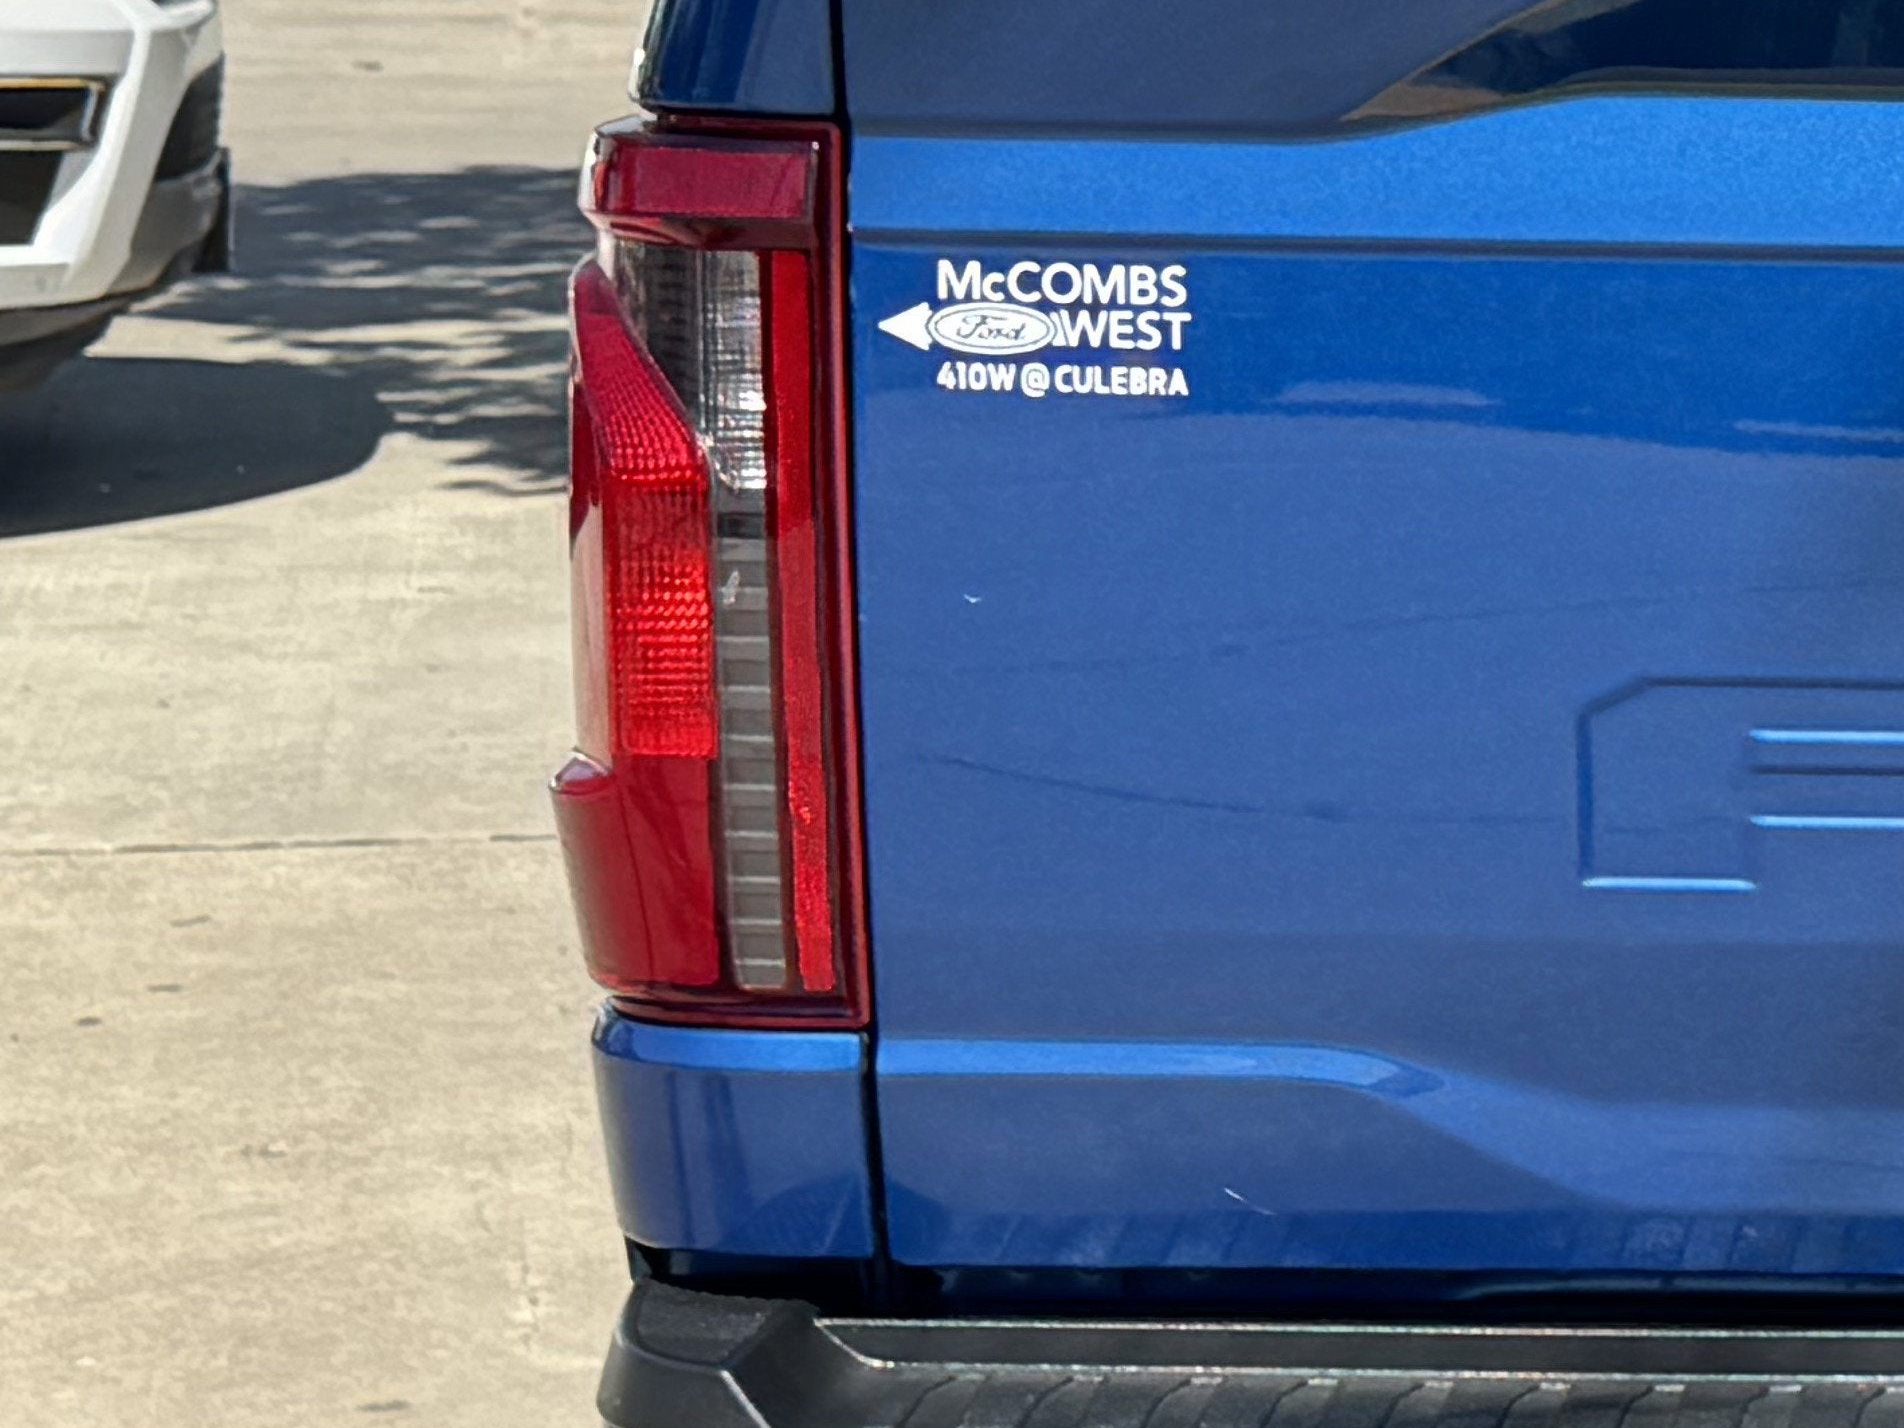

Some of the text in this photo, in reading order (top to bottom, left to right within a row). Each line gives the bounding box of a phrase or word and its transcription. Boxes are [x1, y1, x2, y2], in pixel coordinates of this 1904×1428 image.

[936, 258, 1188, 307] McCOMBS
[955, 309, 1192, 351] Ford WEST
